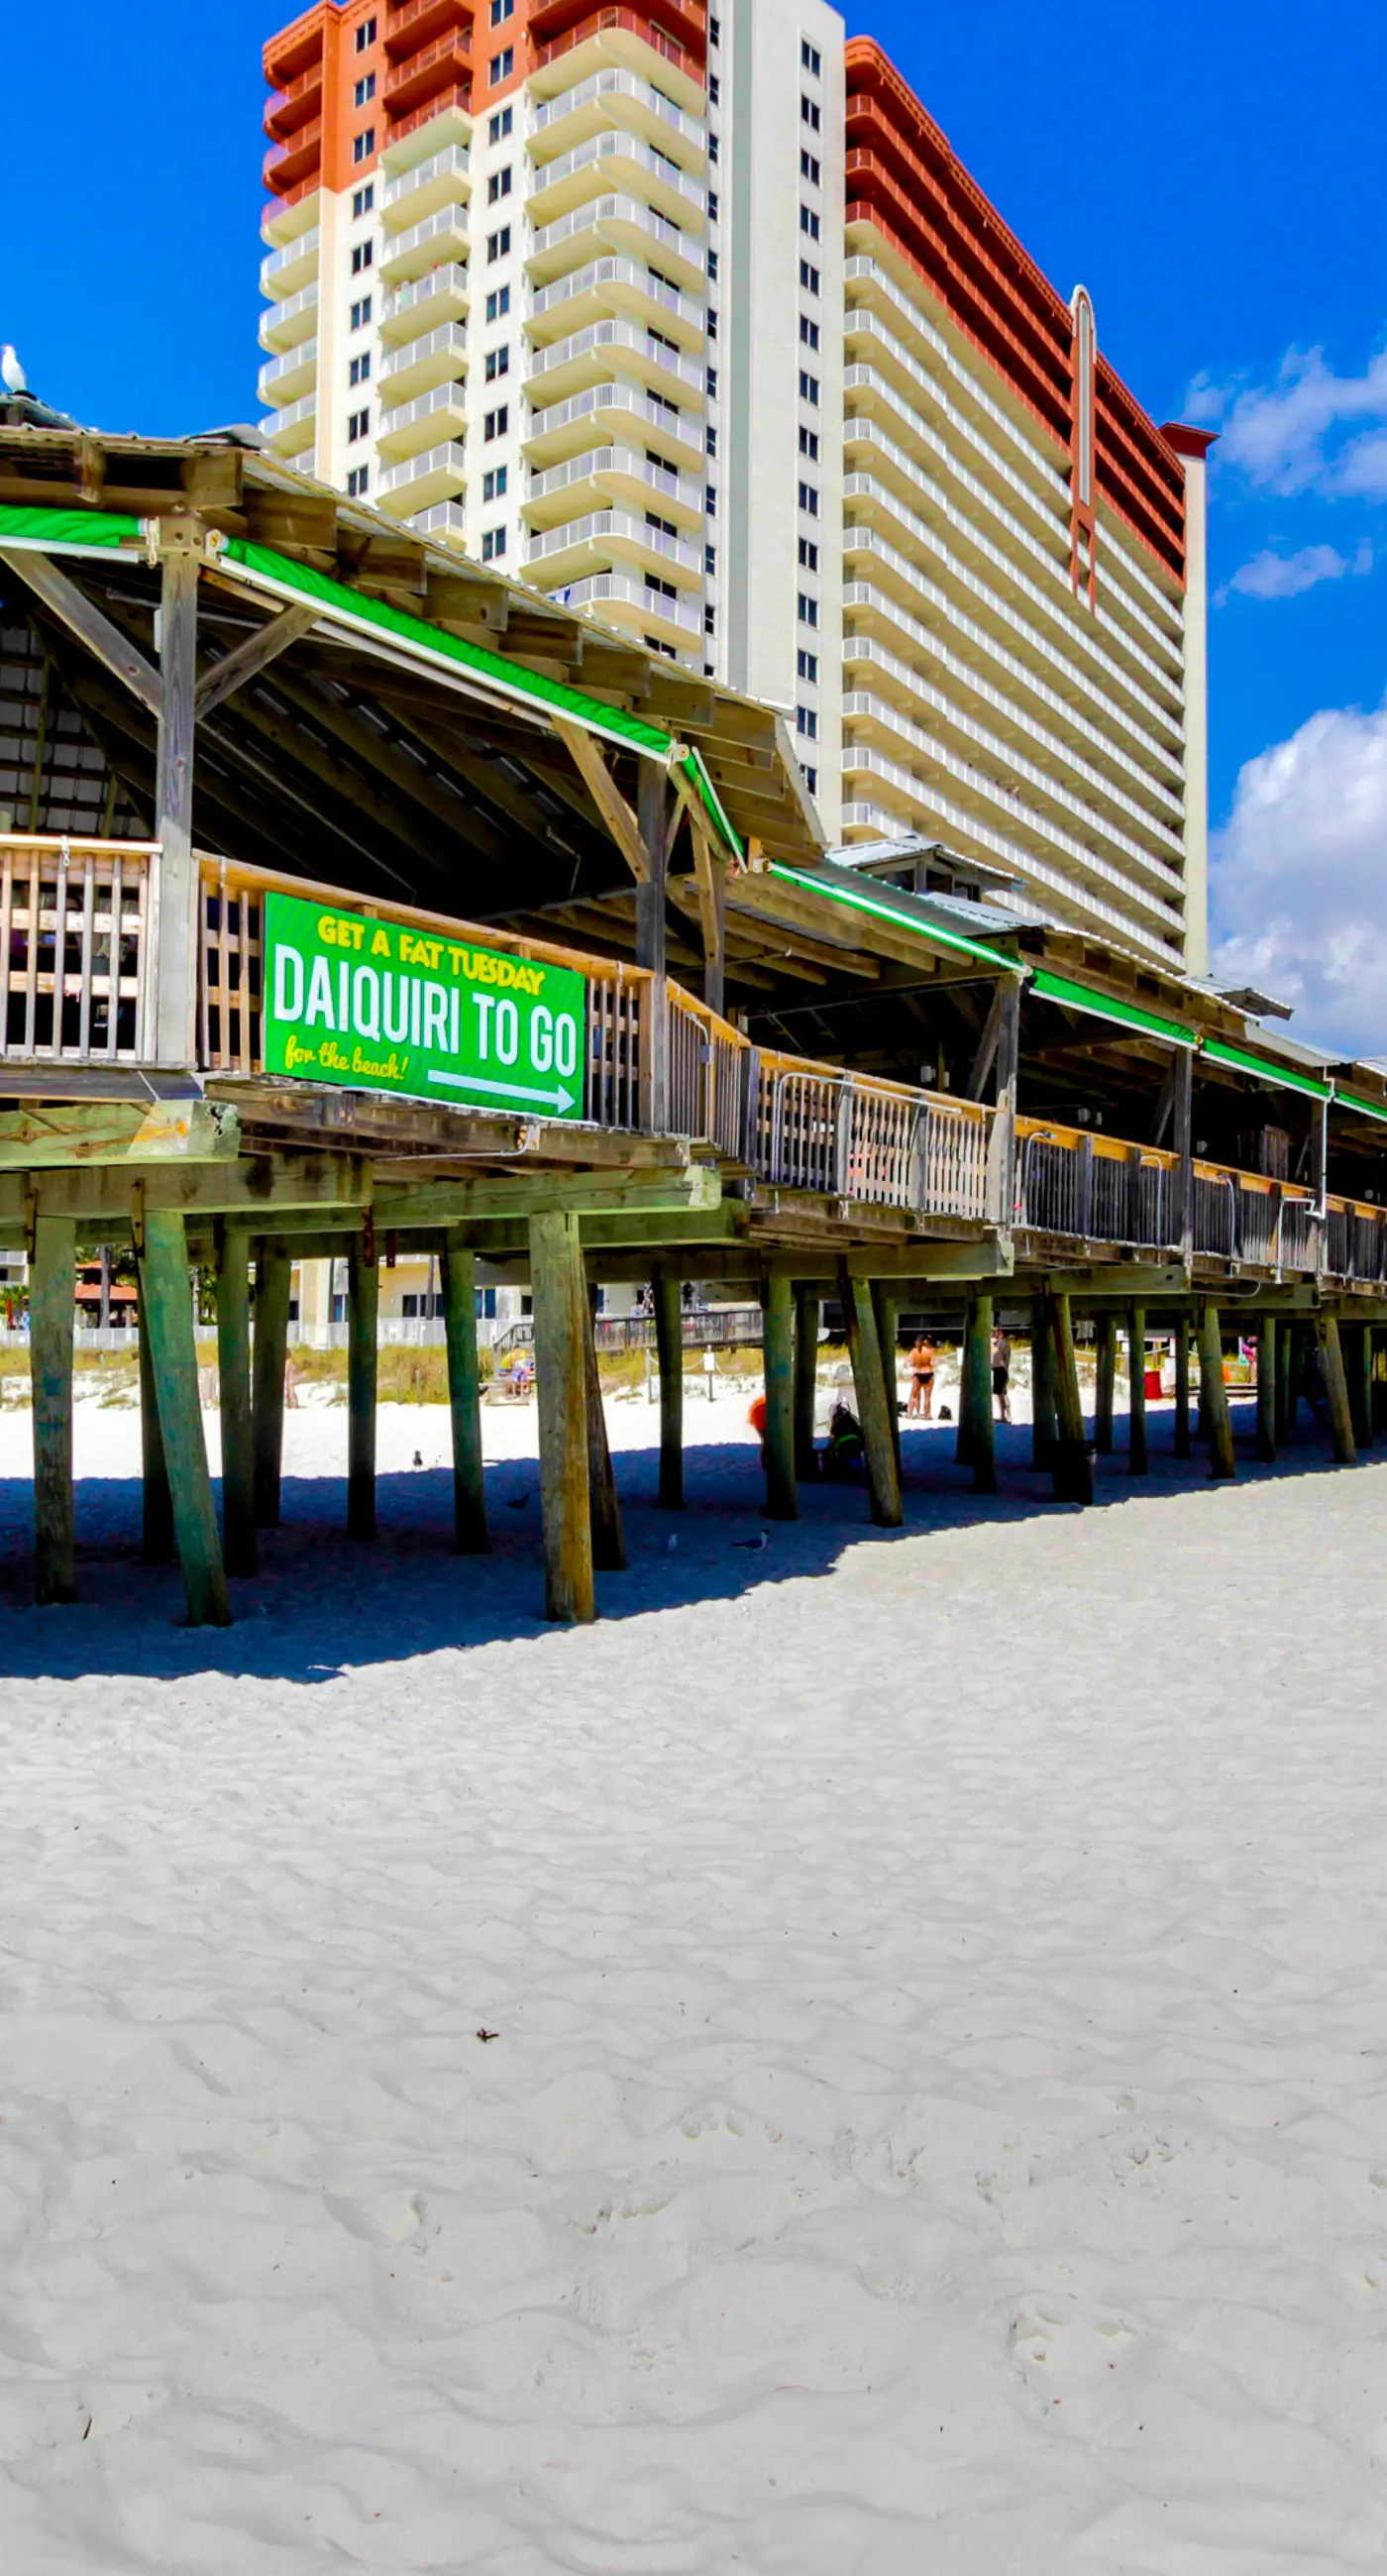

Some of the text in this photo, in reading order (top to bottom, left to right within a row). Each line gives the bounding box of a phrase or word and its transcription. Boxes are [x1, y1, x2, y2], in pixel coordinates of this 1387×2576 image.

[317, 915, 545, 996] GET A FAT TUESDAY
[273, 942, 578, 1078] DAIQUIRI TO GO
[284, 1035, 408, 1080] for the beach!
